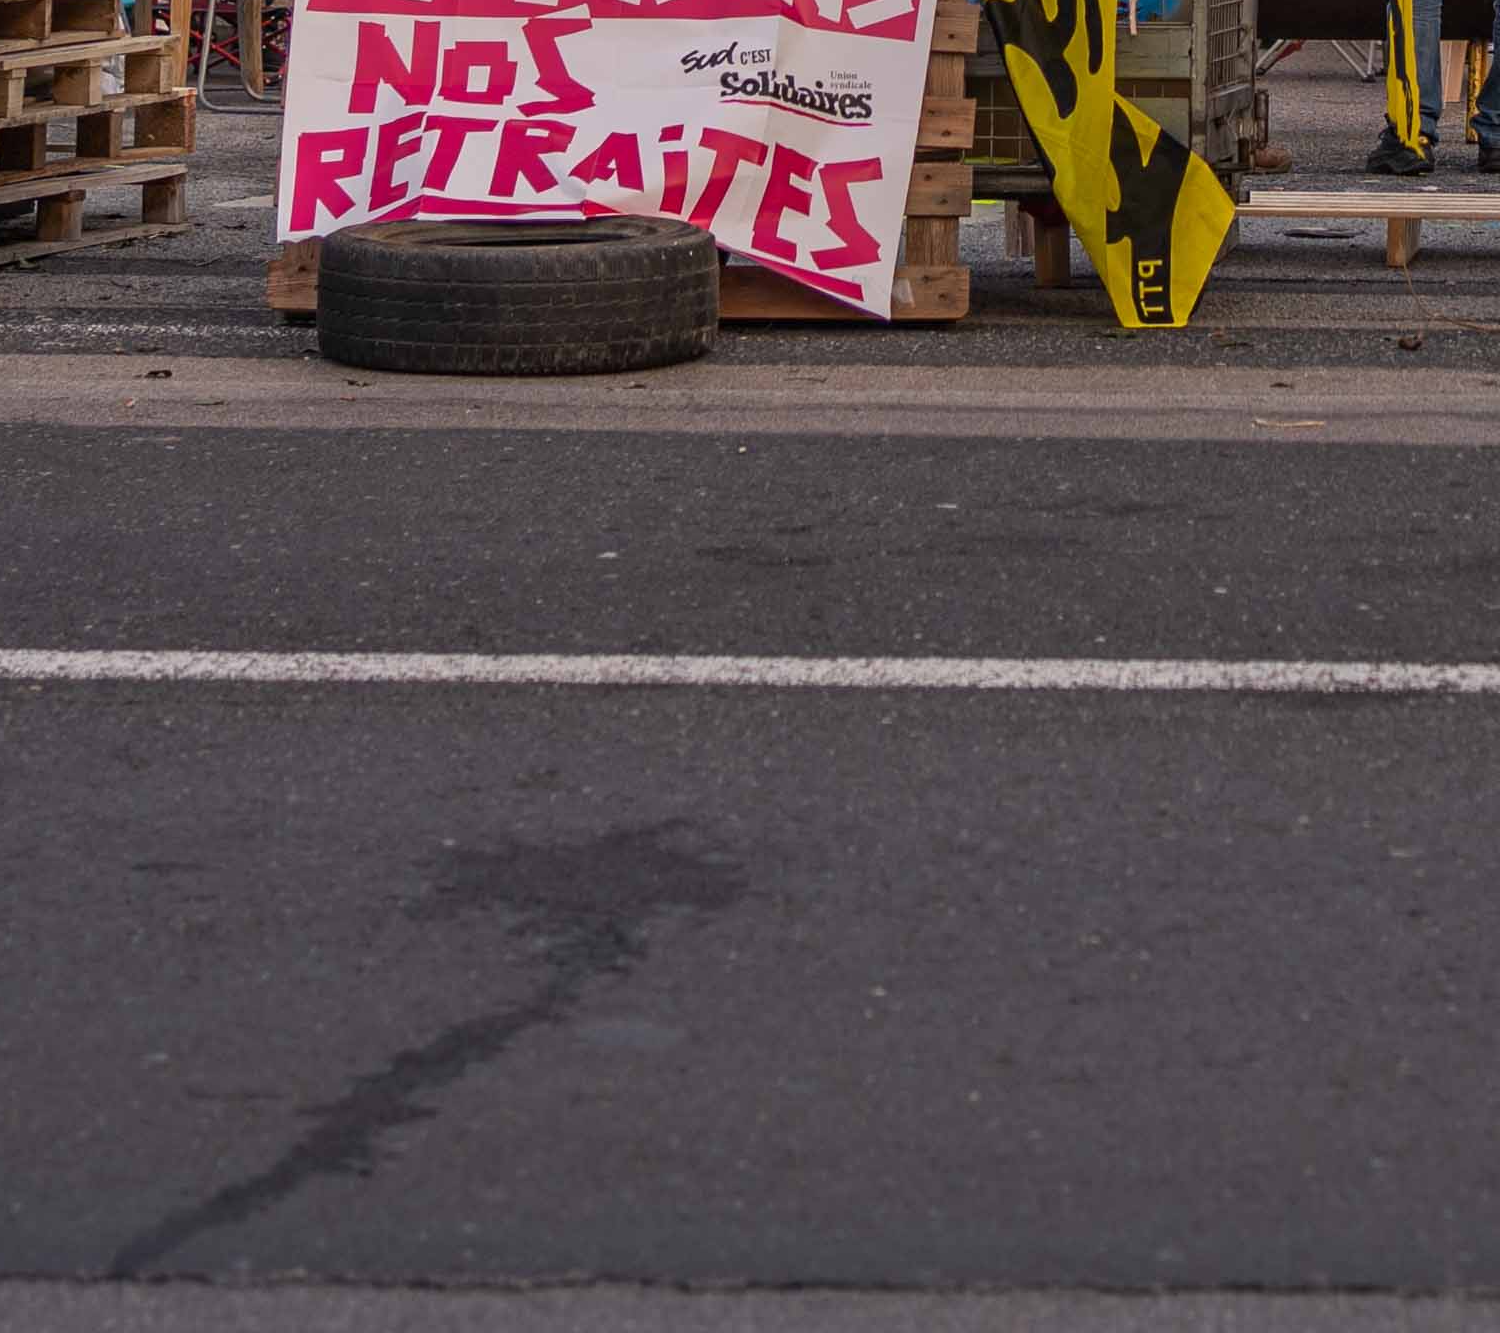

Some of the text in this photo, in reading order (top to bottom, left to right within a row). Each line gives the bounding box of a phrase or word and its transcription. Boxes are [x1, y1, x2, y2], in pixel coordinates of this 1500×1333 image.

[740, 49, 772, 66] C'EST
[348, 16, 596, 117] NOS
[830, 70, 858, 80] Union
[719, 68, 873, 119] Solidaires
[830, 81, 872, 91] syndicale
